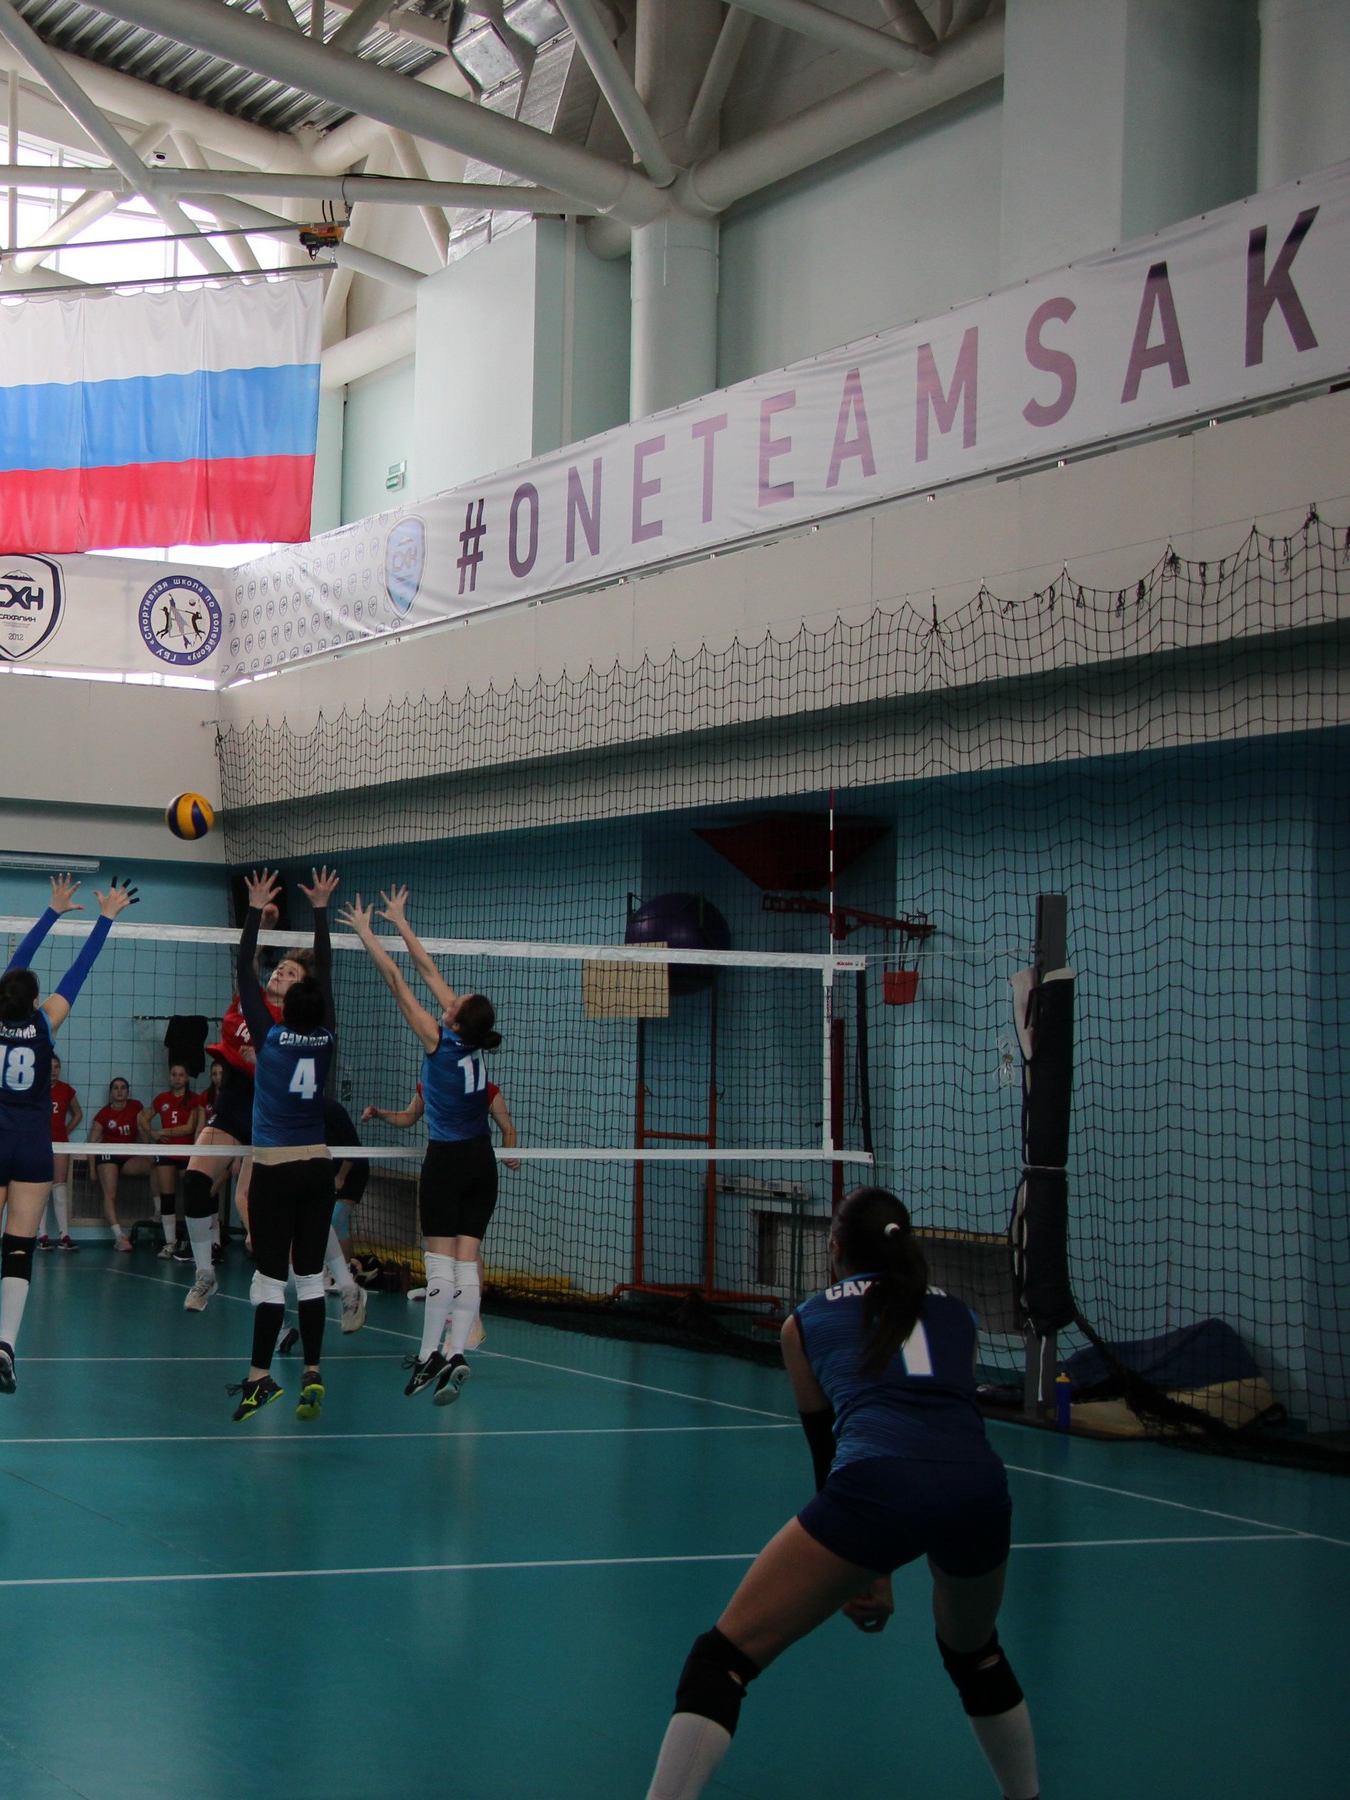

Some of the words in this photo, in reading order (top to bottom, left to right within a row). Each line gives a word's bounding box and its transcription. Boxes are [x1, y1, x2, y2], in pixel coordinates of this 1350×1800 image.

[456, 206, 1322, 596] #ONETEAMSAK
[8, 633, 24, 641] 2012
[156, 648, 177, 662] ГБУ
[205, 594, 215, 608] по
[289, 1058, 318, 1099] 4
[118, 1124, 130, 1136] 10
[171, 1111, 178, 1124] 5
